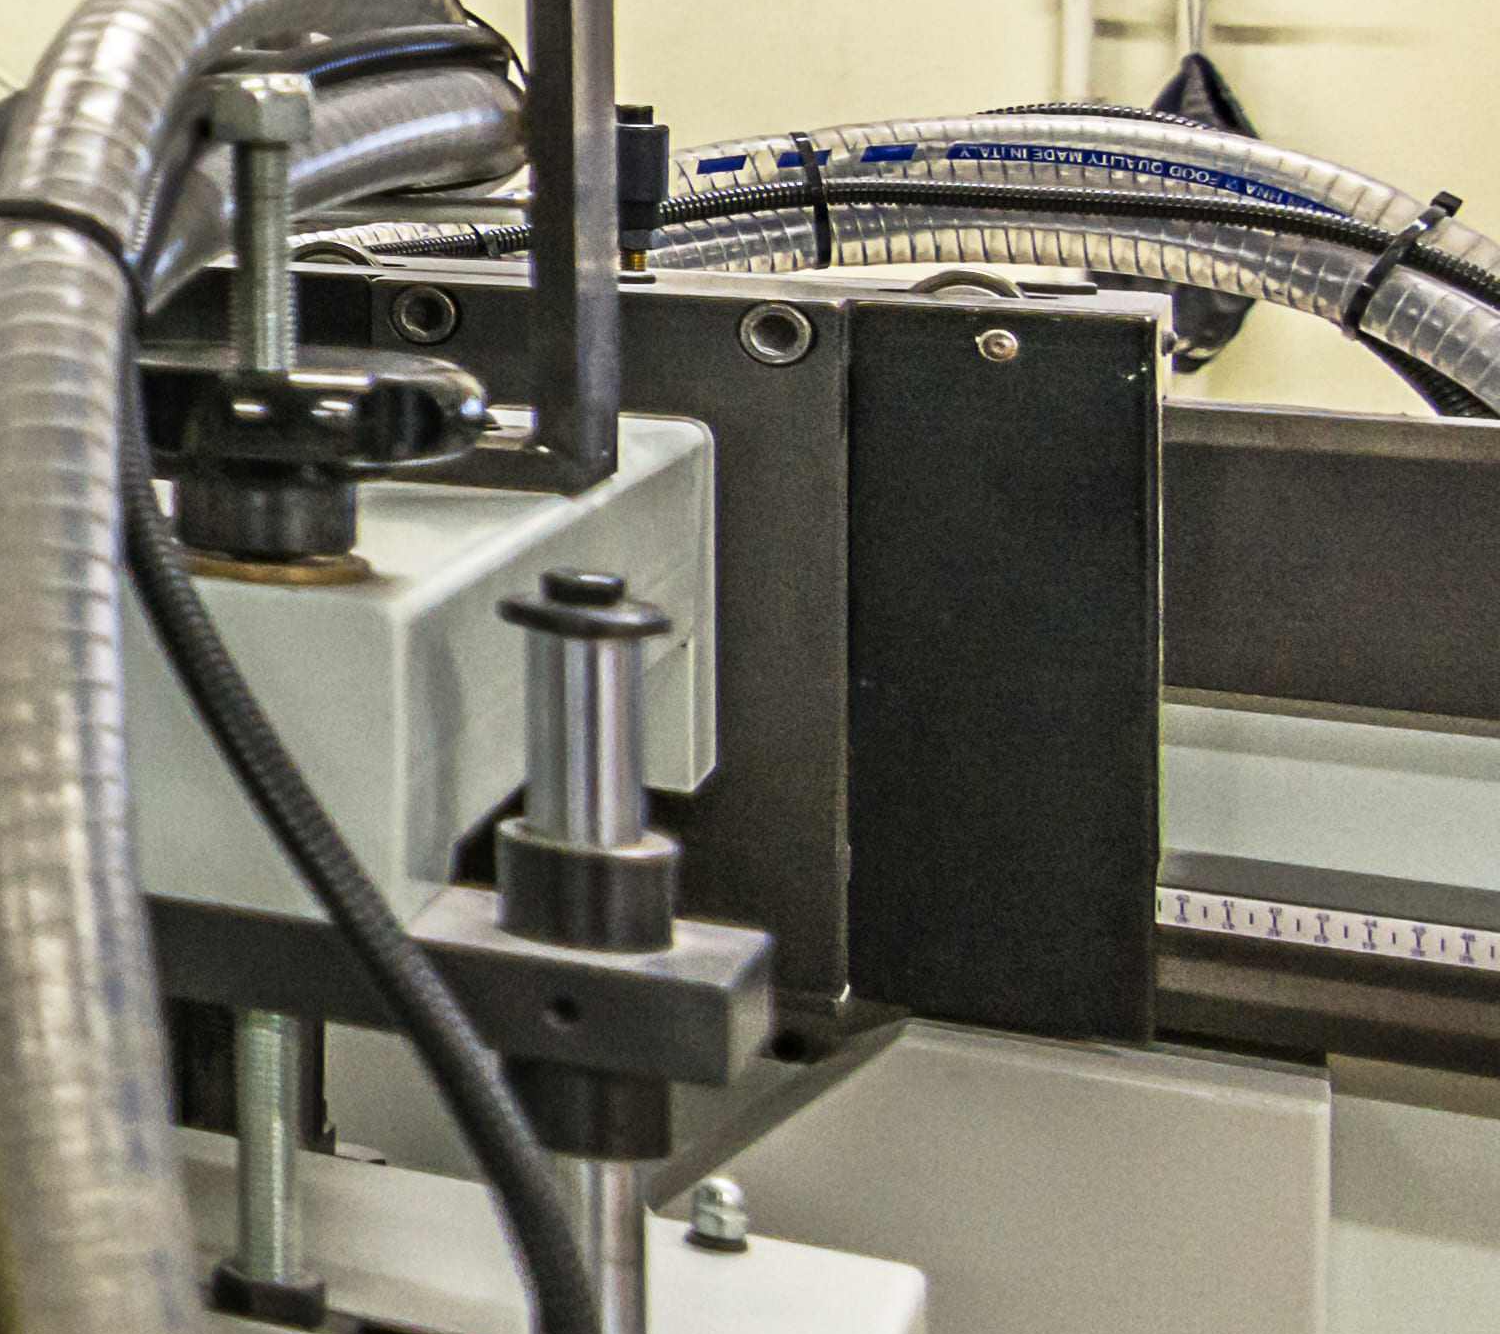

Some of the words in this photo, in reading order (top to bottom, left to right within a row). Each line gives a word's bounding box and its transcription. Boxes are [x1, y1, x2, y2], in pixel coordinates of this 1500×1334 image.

[959, 145, 1007, 159] ITALY
[1011, 147, 1028, 161] IN
[1032, 147, 1083, 164] MADE
[1087, 152, 1163, 175] QUALITY
[1169, 165, 1219, 185] FOOD
